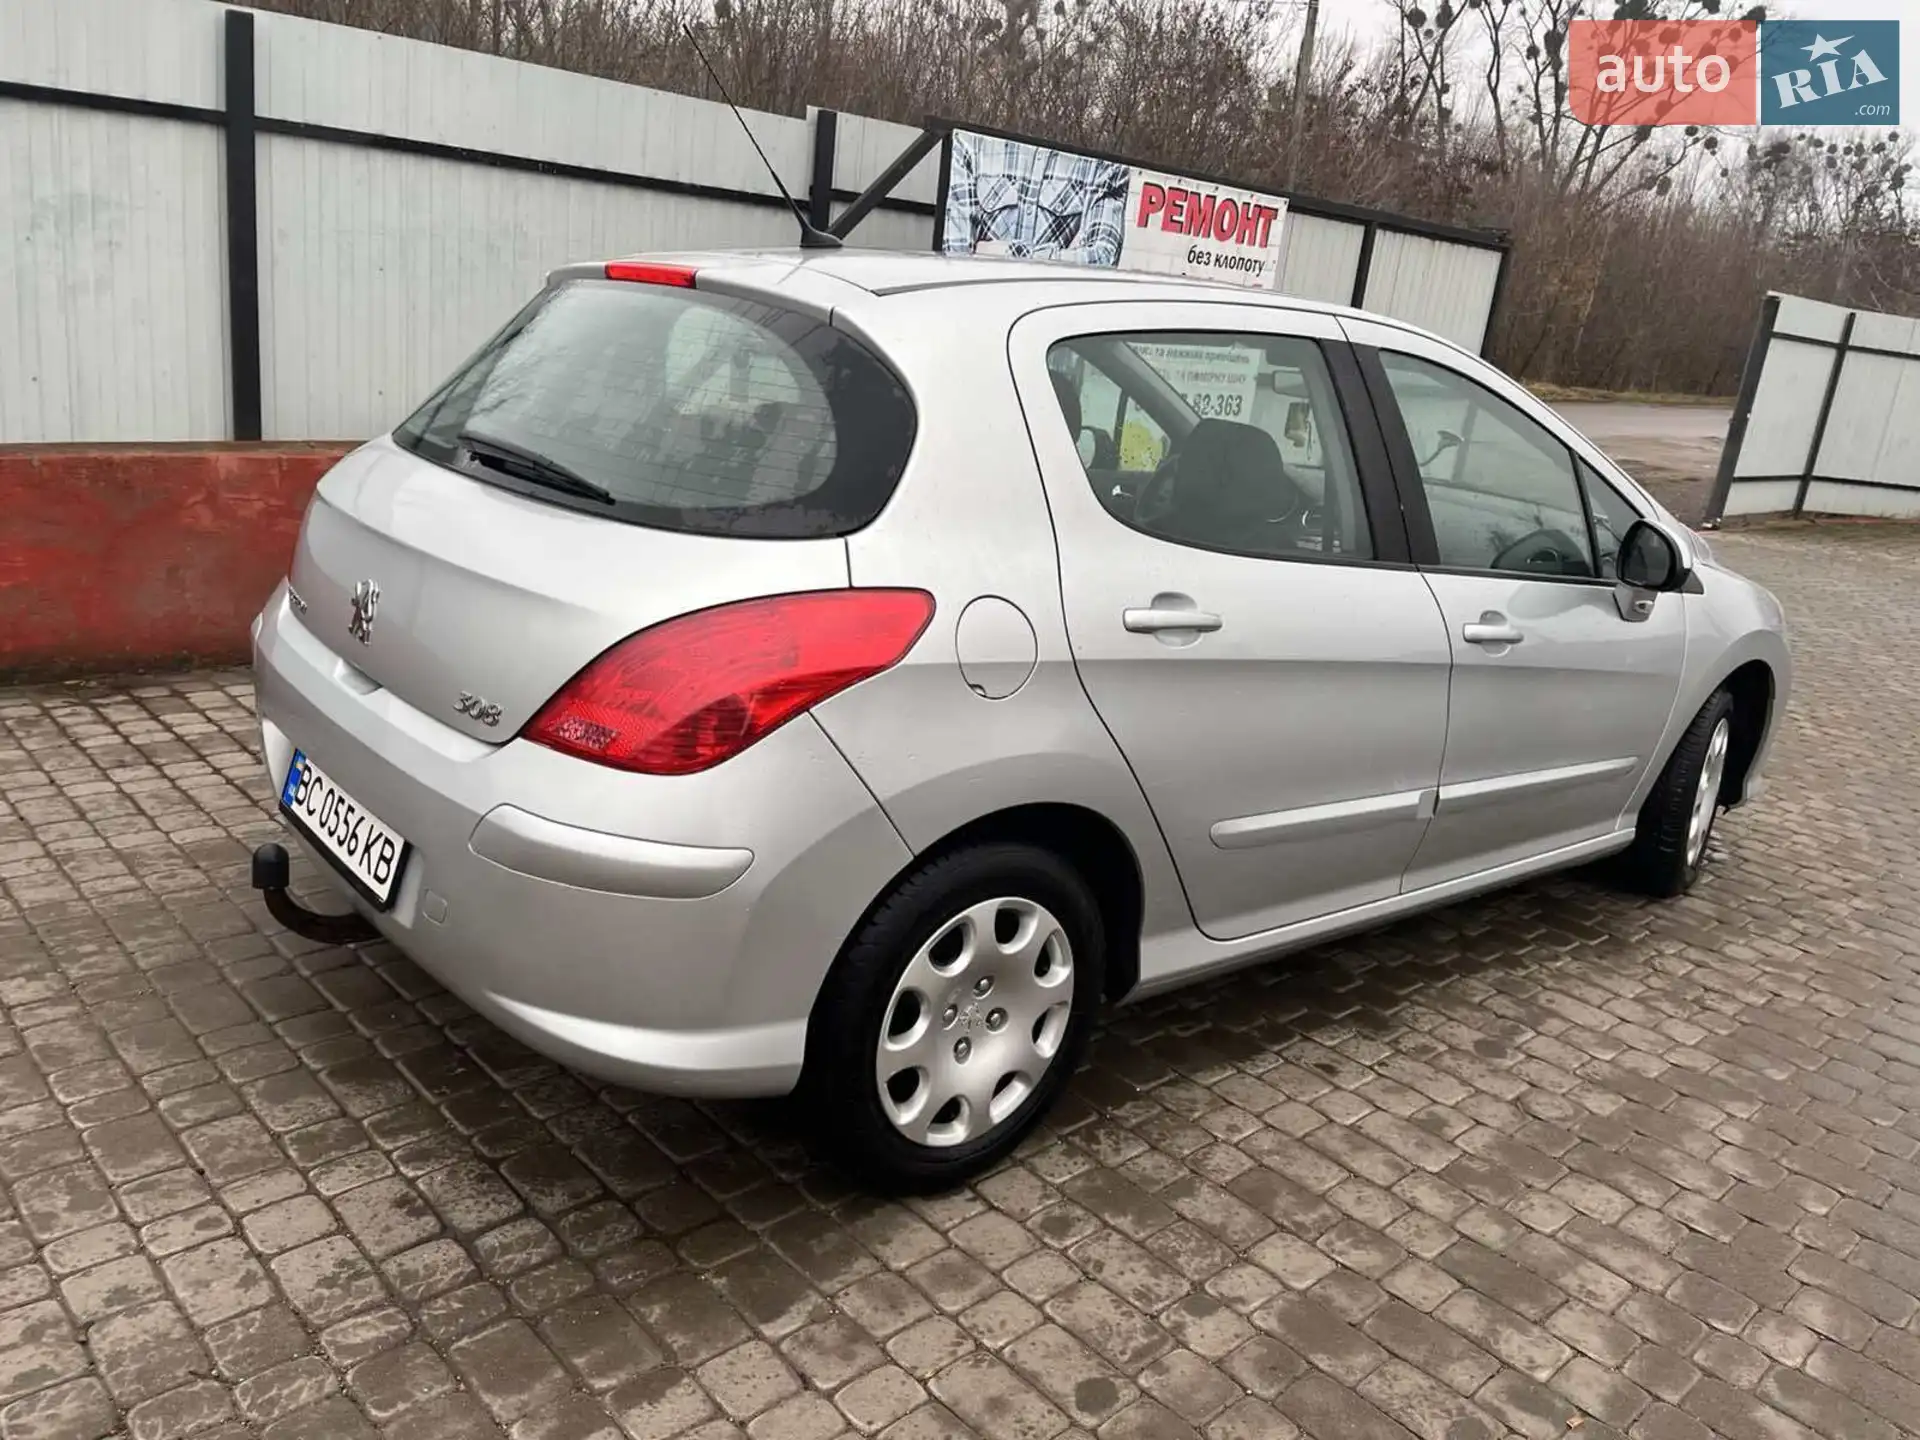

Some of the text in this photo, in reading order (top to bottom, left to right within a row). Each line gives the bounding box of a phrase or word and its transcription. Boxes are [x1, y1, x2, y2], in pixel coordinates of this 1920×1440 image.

[1136, 181, 1279, 248] РЕМОНТ
[1187, 244, 1266, 278] без клопоту
[452, 690, 503, 727] 308
